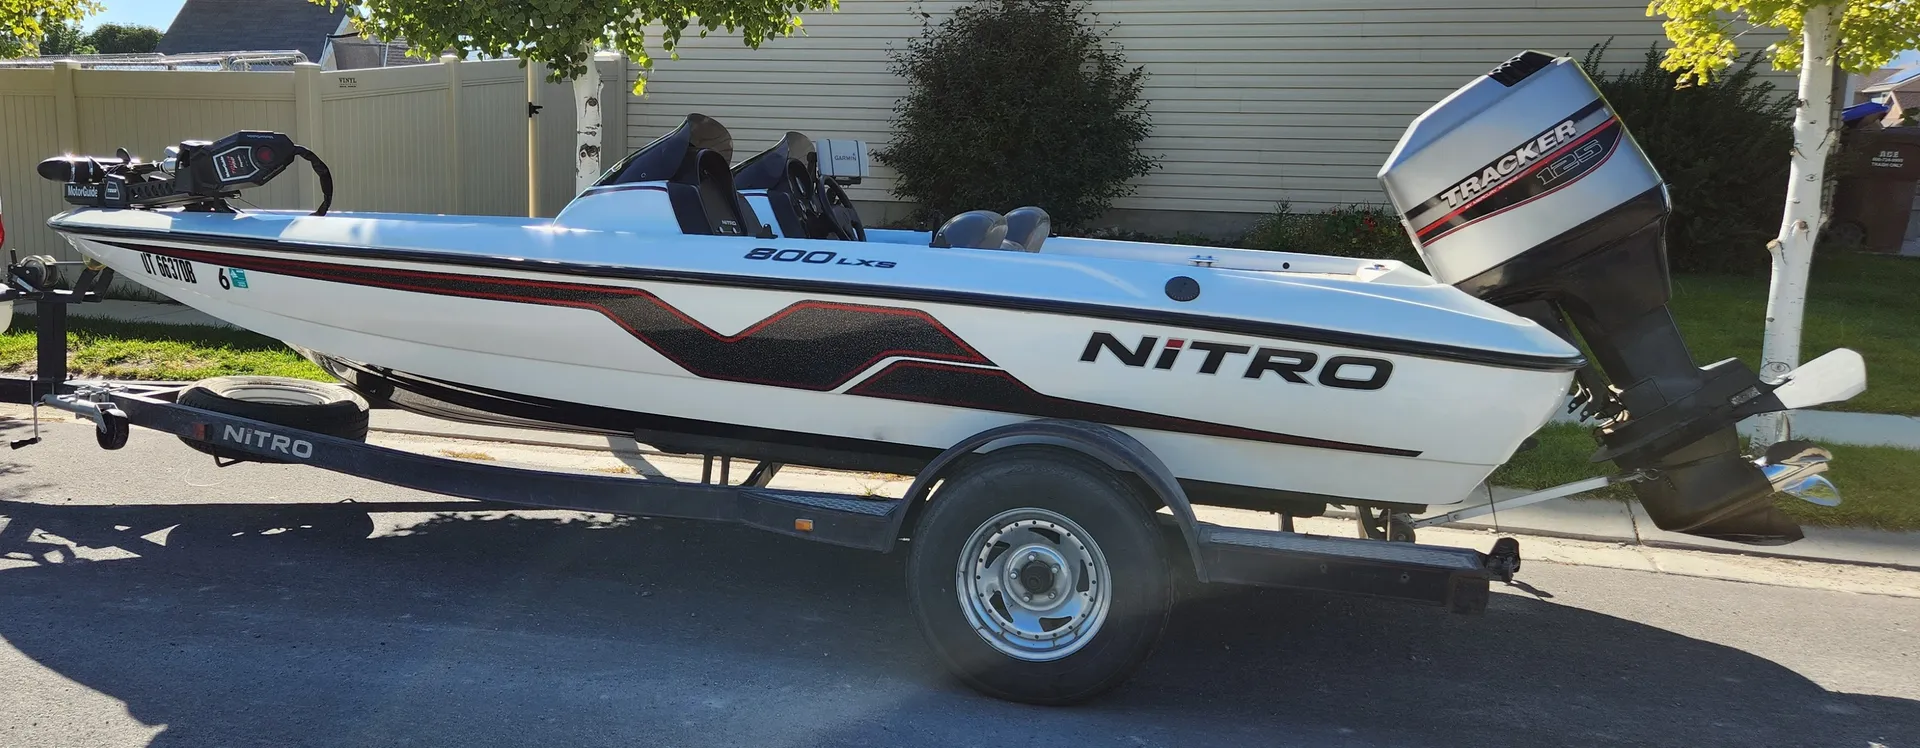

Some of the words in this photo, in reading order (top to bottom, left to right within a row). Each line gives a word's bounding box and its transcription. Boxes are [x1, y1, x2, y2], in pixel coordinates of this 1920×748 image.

[1440, 119, 1577, 207] TRACKER
[1536, 139, 1603, 186] 125
[67, 185, 98, 198] MotorGuide
[140, 252, 157, 276] UT
[743, 247, 837, 264] 800
[836, 257, 898, 269] LXS
[218, 267, 231, 291] 6
